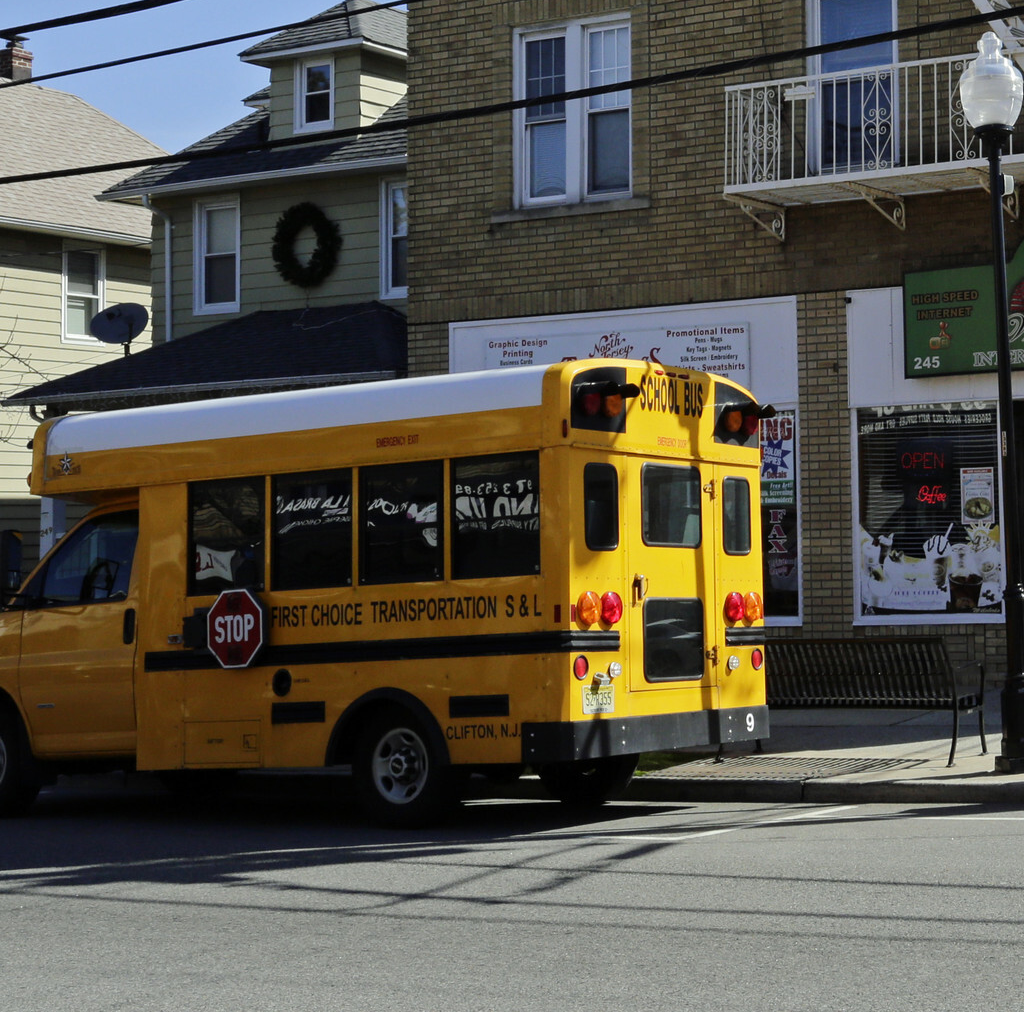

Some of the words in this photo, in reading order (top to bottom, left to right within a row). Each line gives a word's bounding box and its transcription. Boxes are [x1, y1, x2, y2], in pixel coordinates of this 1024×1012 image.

[911, 292, 940, 305] HIGH
[942, 289, 979, 303] SPEED
[917, 306, 973, 321] INTERNET
[666, 327, 718, 338] Promotional
[720, 326, 745, 335] Items
[488, 340, 519, 349] Graphic
[521, 339, 548, 348] Design
[589, 332, 626, 357] North
[503, 349, 534, 358] Printing
[702, 363, 745, 372] Sweatshirts
[914, 356, 941, 370] 245
[640, 374, 680, 415] SCHOOL
[684, 382, 703, 419] BUS
[408, 434, 419, 445] EXIT
[763, 446, 782, 457] COLOR
[901, 452, 945, 469] OPEN
[766, 471, 787, 479] Decals
[917, 485, 947, 504] Coffee
[271, 605, 307, 628] FIRST
[311, 602, 362, 626] CHOICE
[371, 595, 497, 623] TRANSPORTATION
[505, 595, 514, 617] S
[519, 594, 529, 617] &
[533, 594, 542, 617] L
[214, 614, 254, 643] STOP
[746, 713, 754, 733] 9
[446, 724, 498, 741] CLIFTON,
[500, 723, 521, 738] N.J.
